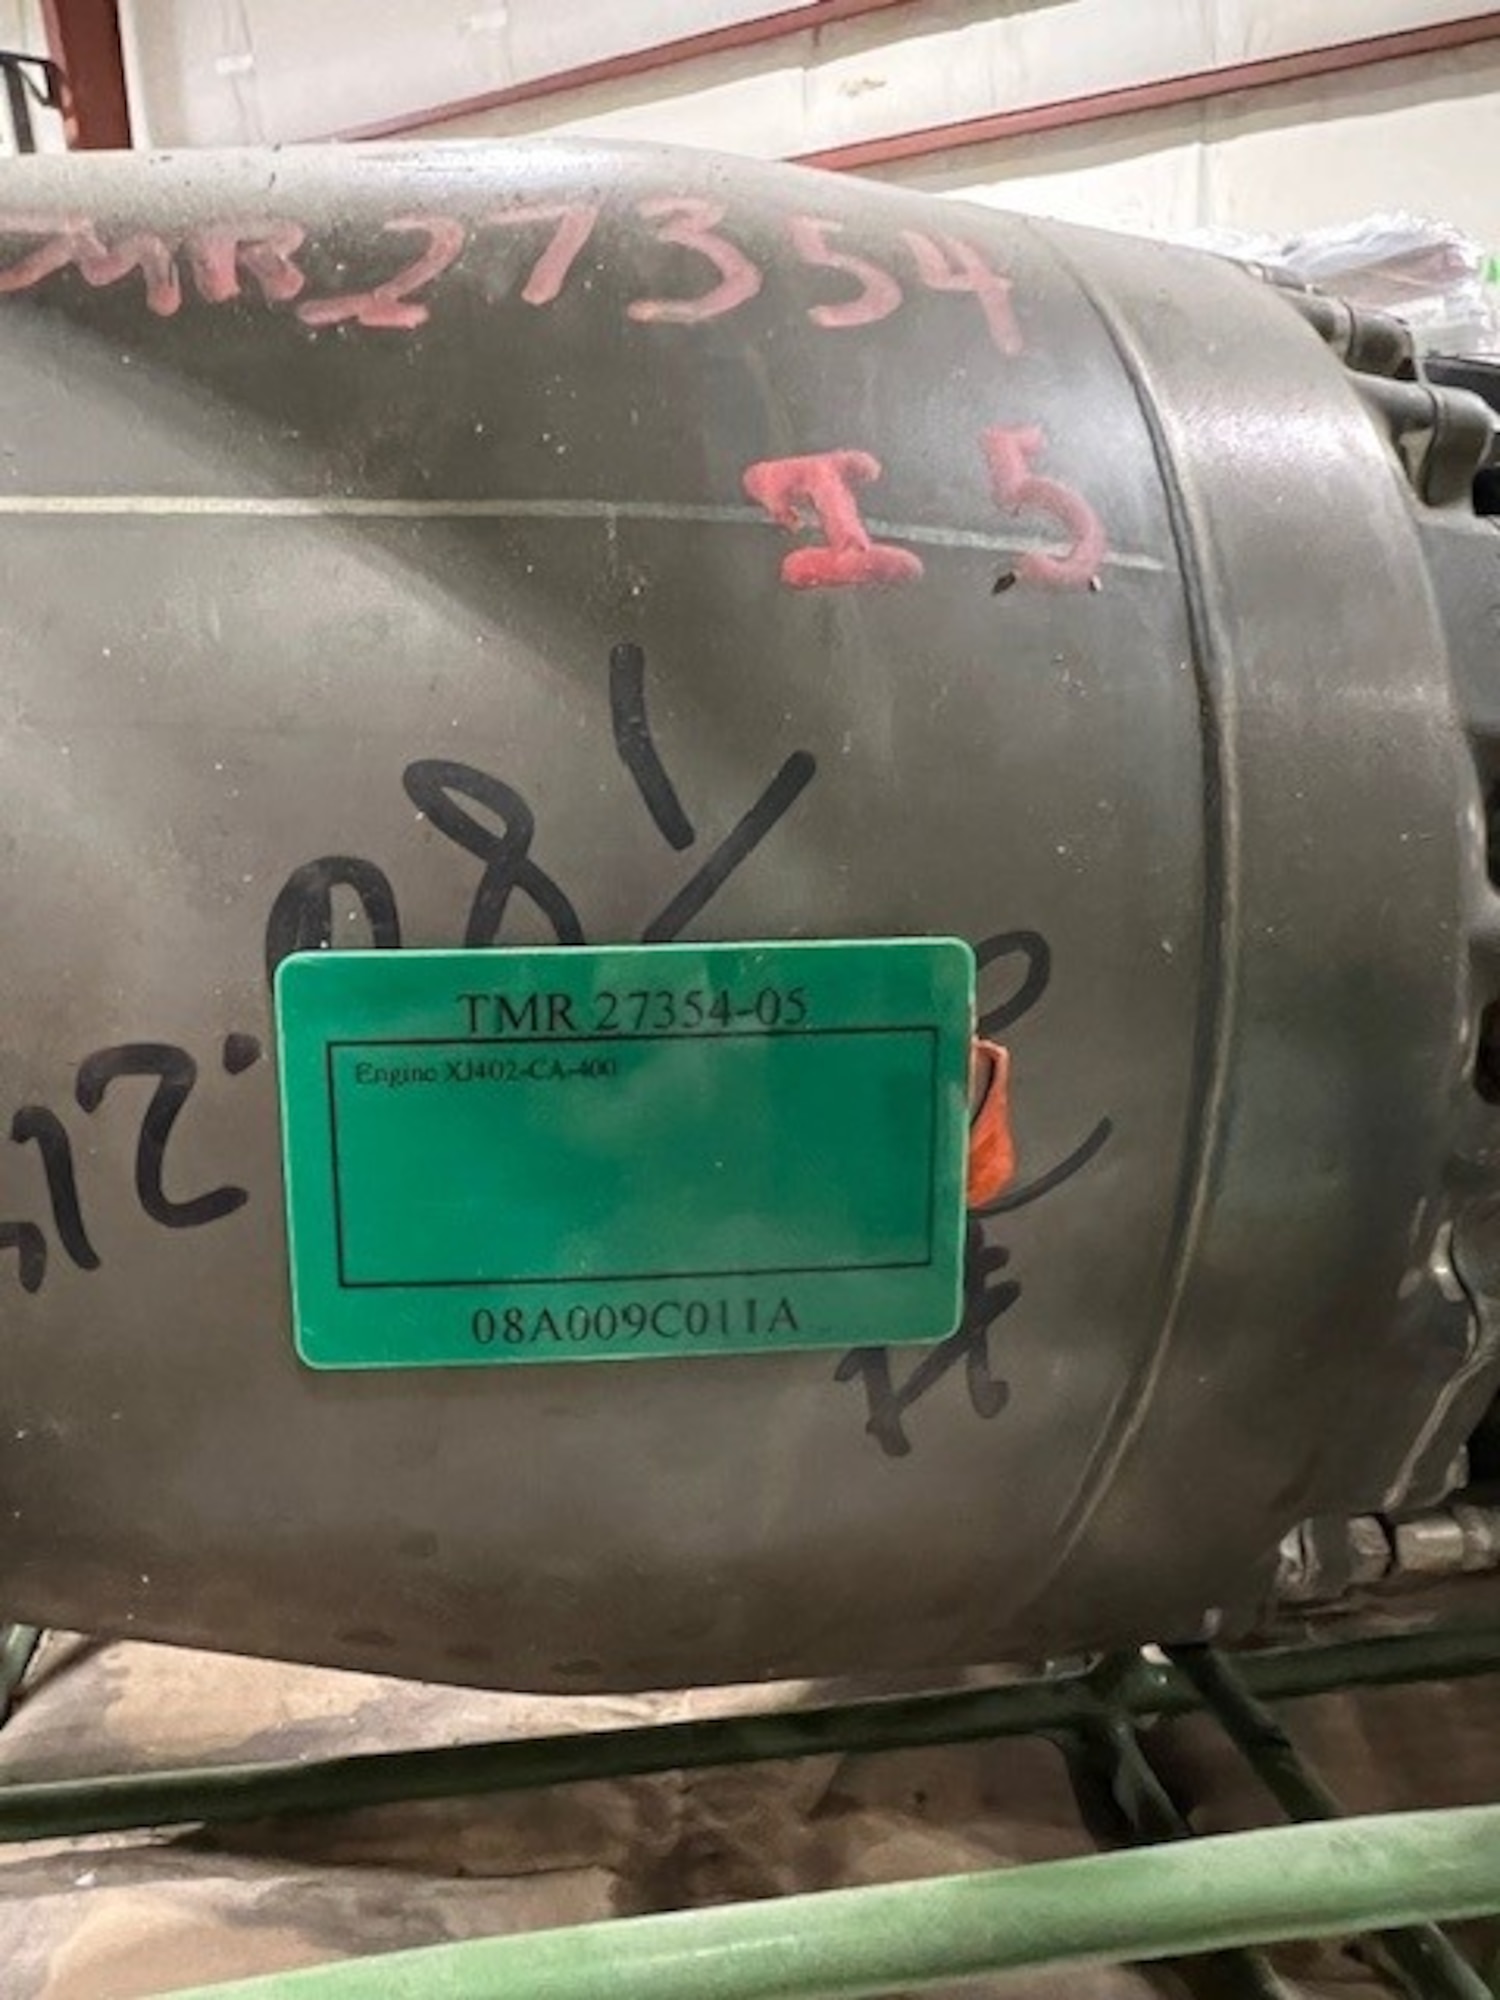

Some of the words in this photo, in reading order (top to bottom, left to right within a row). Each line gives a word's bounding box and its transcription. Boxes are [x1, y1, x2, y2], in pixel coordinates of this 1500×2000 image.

[980, 423, 1106, 592] 5
[457, 991, 579, 1035] TMR
[594, 985, 809, 1030] 27354-05
[354, 1061, 438, 1088] Engine
